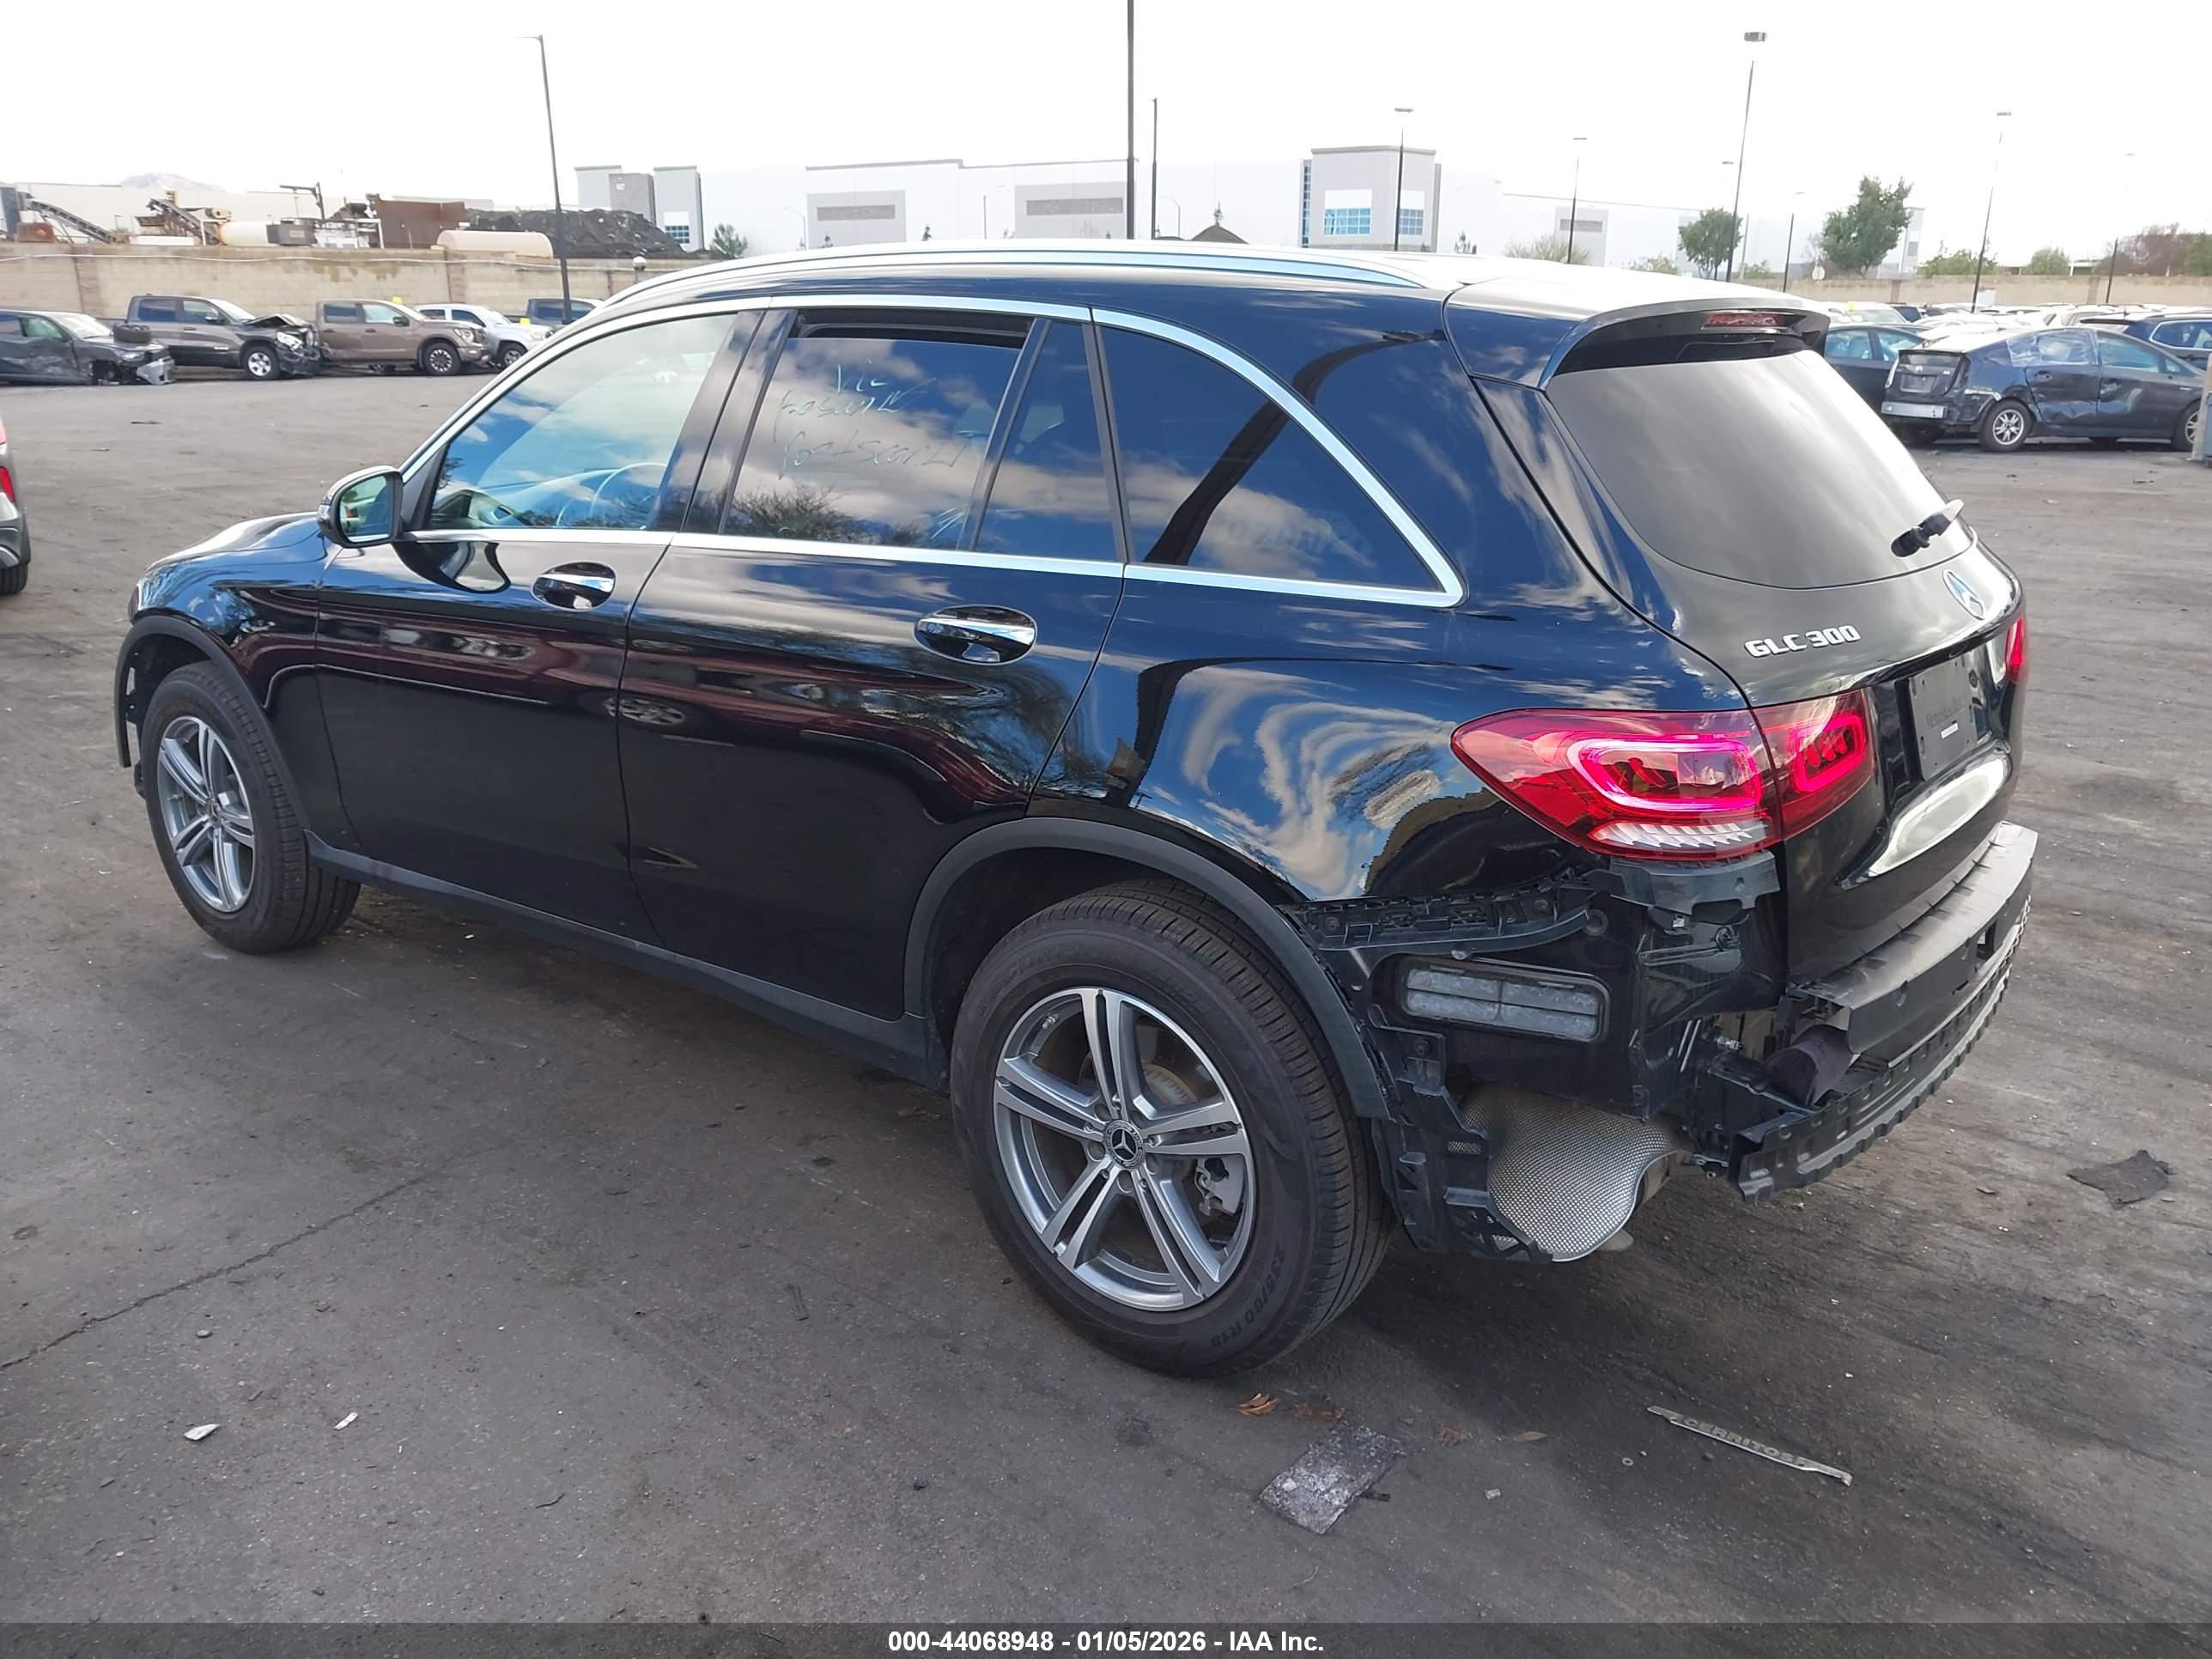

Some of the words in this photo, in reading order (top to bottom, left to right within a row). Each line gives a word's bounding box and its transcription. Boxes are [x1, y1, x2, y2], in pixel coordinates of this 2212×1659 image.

[1744, 634, 1808, 658] GLC
[1805, 624, 1862, 649] 300
[1684, 1417, 1796, 1463] CERRITOS
